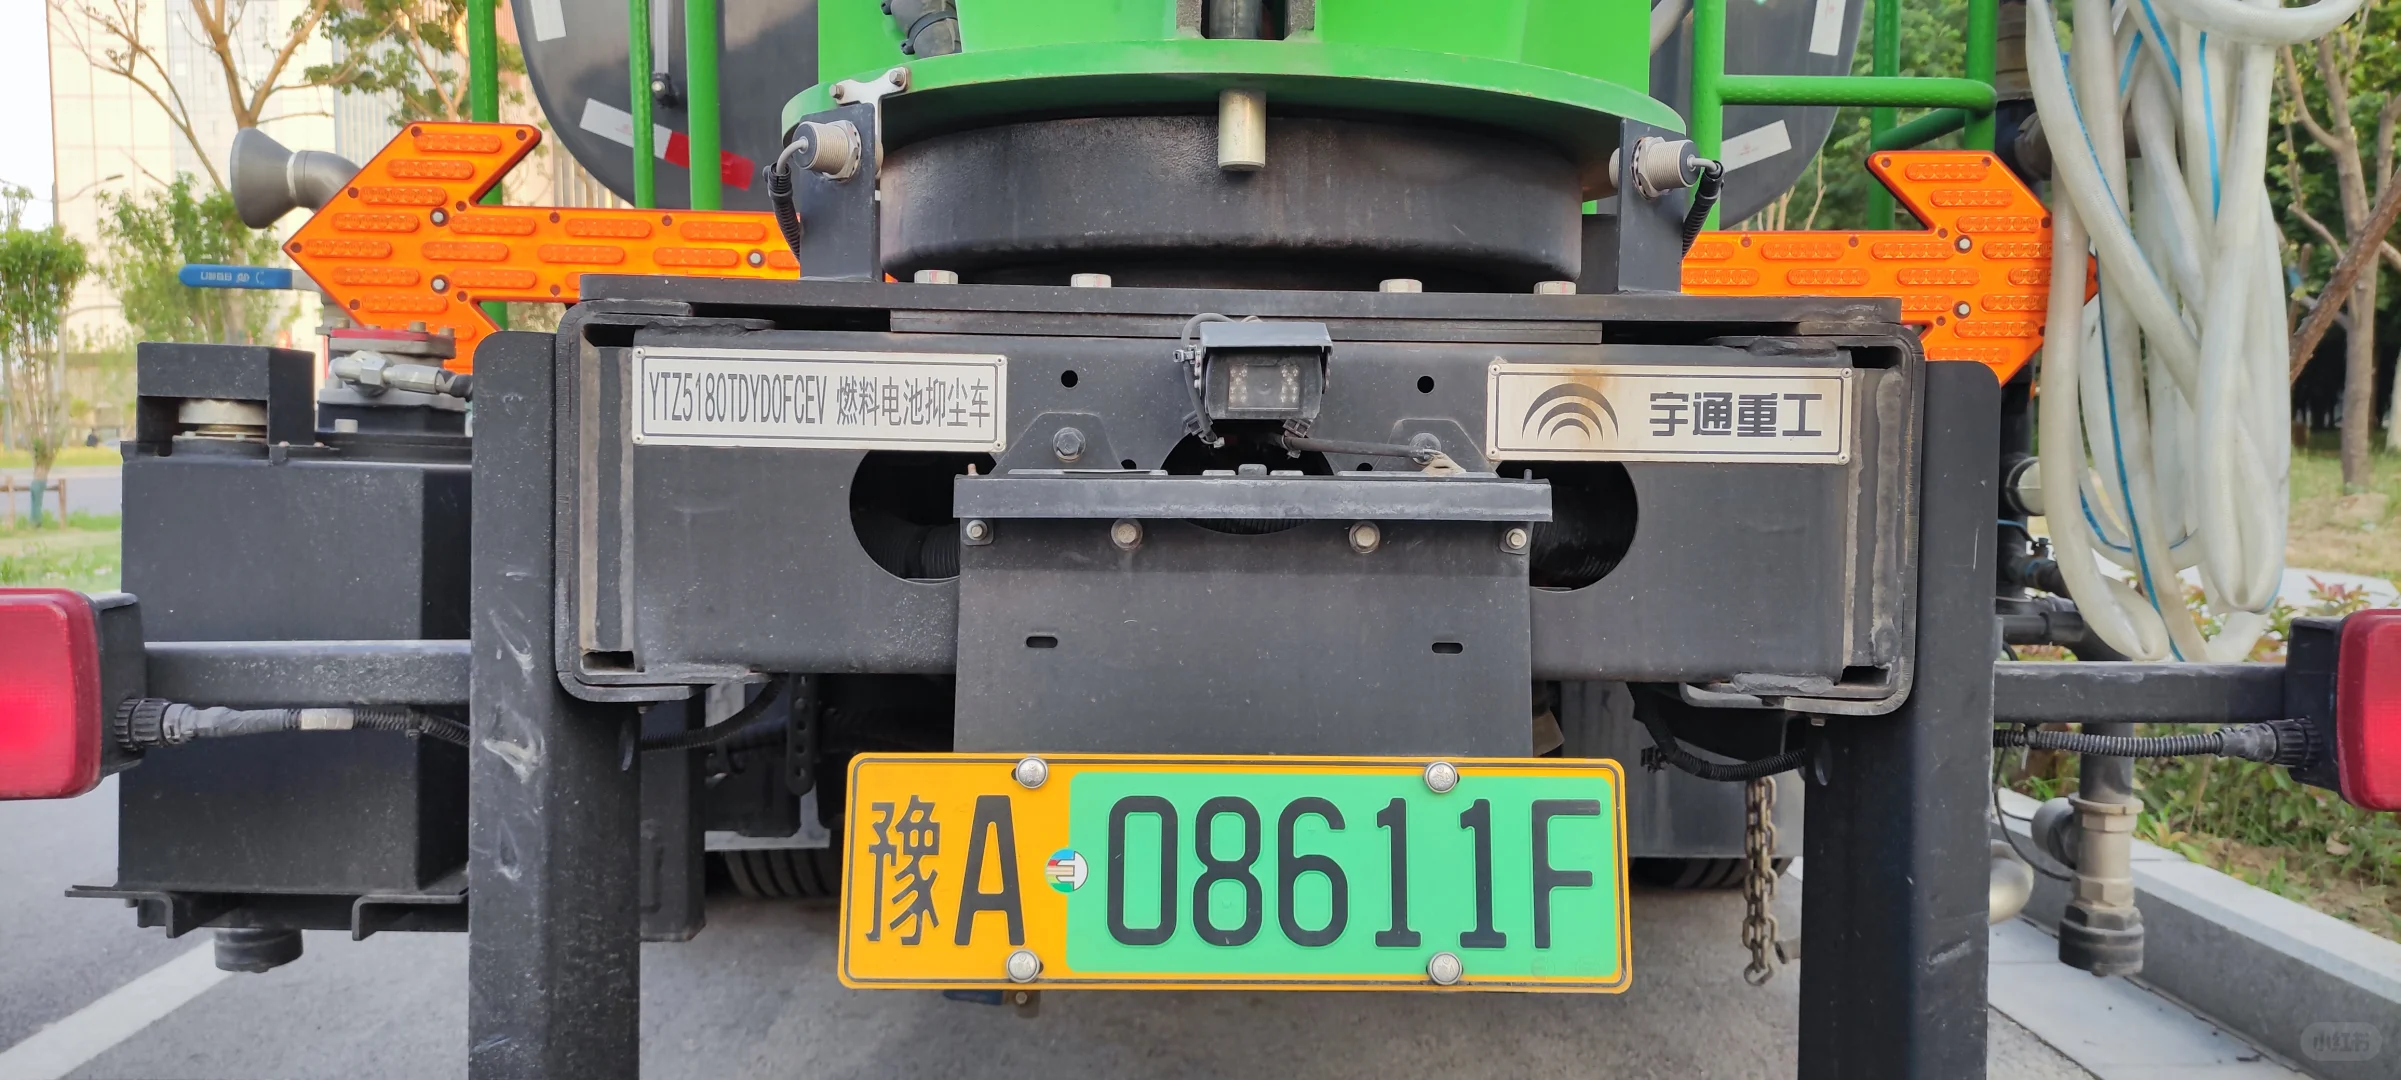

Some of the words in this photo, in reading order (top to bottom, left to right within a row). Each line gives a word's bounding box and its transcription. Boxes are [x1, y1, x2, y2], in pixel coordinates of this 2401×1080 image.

[836, 376, 991, 428] 燃料电池抑尘车
[1649, 391, 1823, 438] 宇通重工
[866, 794, 1026, 947] 豫A
[1106, 795, 1602, 950] 08611F
